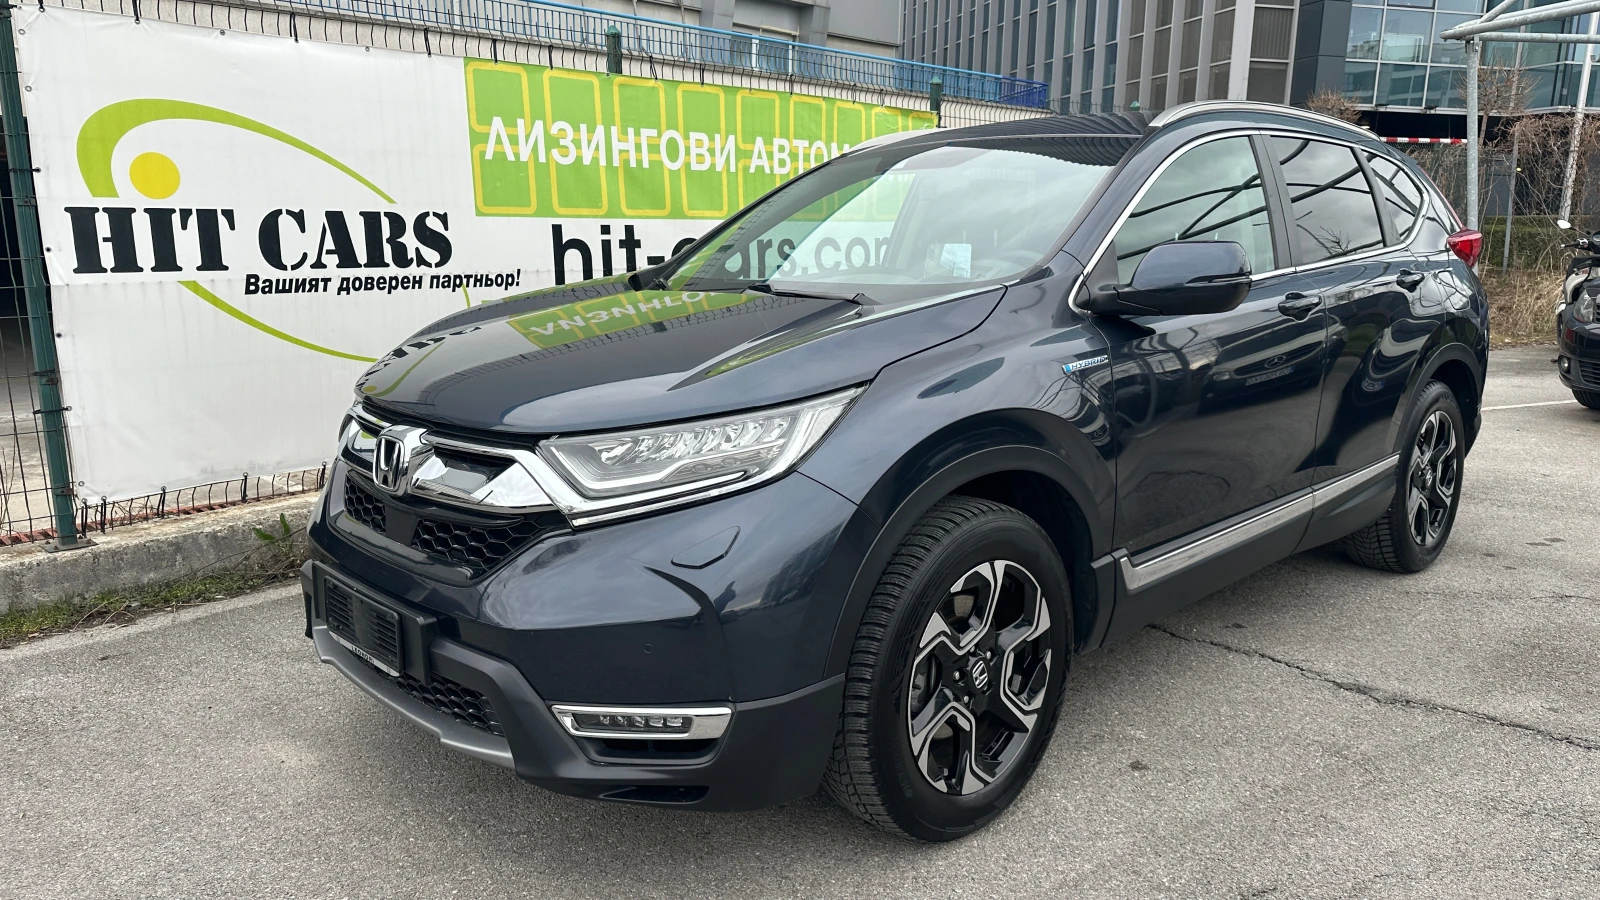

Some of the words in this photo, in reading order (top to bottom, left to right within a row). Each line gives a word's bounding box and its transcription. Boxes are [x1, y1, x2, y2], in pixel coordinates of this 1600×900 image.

[485, 116, 737, 172] ЛИЗИНГОВИ
[63, 206, 236, 274] HIT
[258, 207, 453, 271] CARS
[244, 273, 332, 295] Вашият
[336, 273, 423, 296] доверен
[428, 268, 521, 291] партньор!
[1071, 357, 1107, 370] HYBRID
